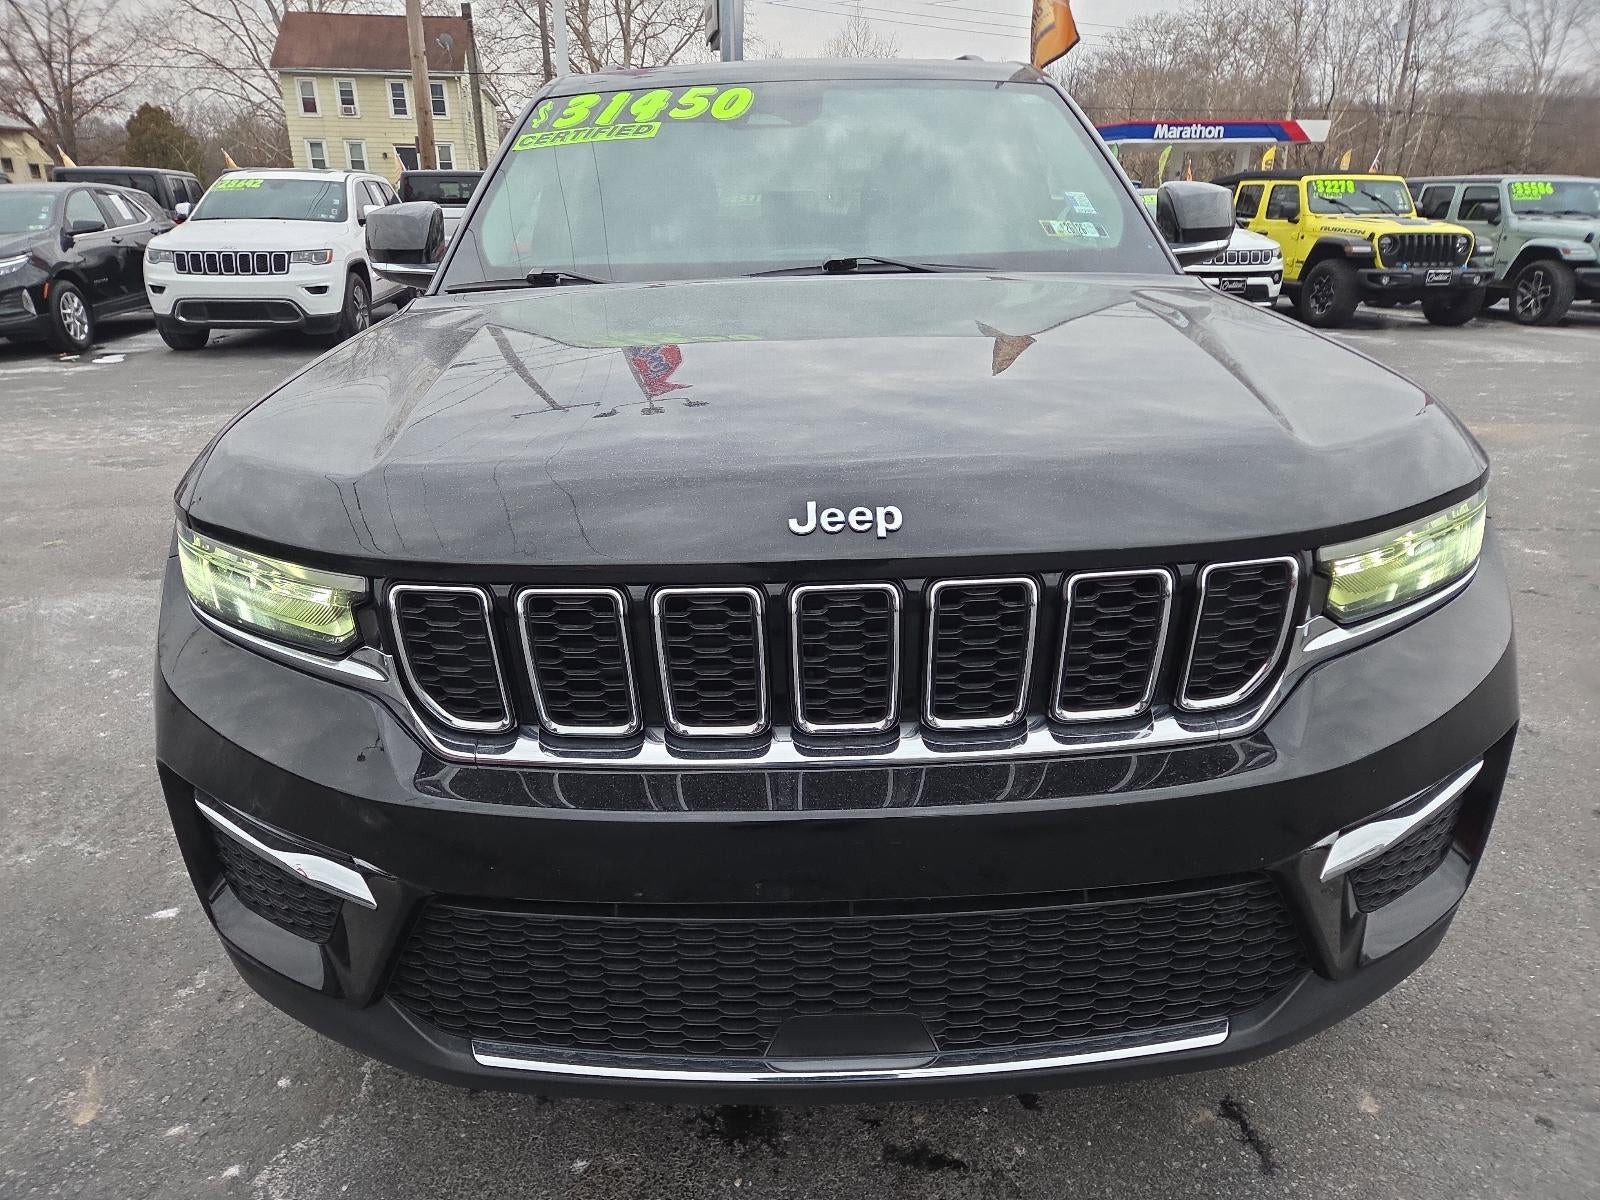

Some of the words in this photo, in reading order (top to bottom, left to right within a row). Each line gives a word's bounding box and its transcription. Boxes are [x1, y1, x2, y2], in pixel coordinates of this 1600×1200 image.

[518, 124, 655, 149] CERTIFIED
[1153, 123, 1225, 139] Marathon
[1319, 226, 1366, 235] RUBICON
[788, 500, 903, 539] Jeep
